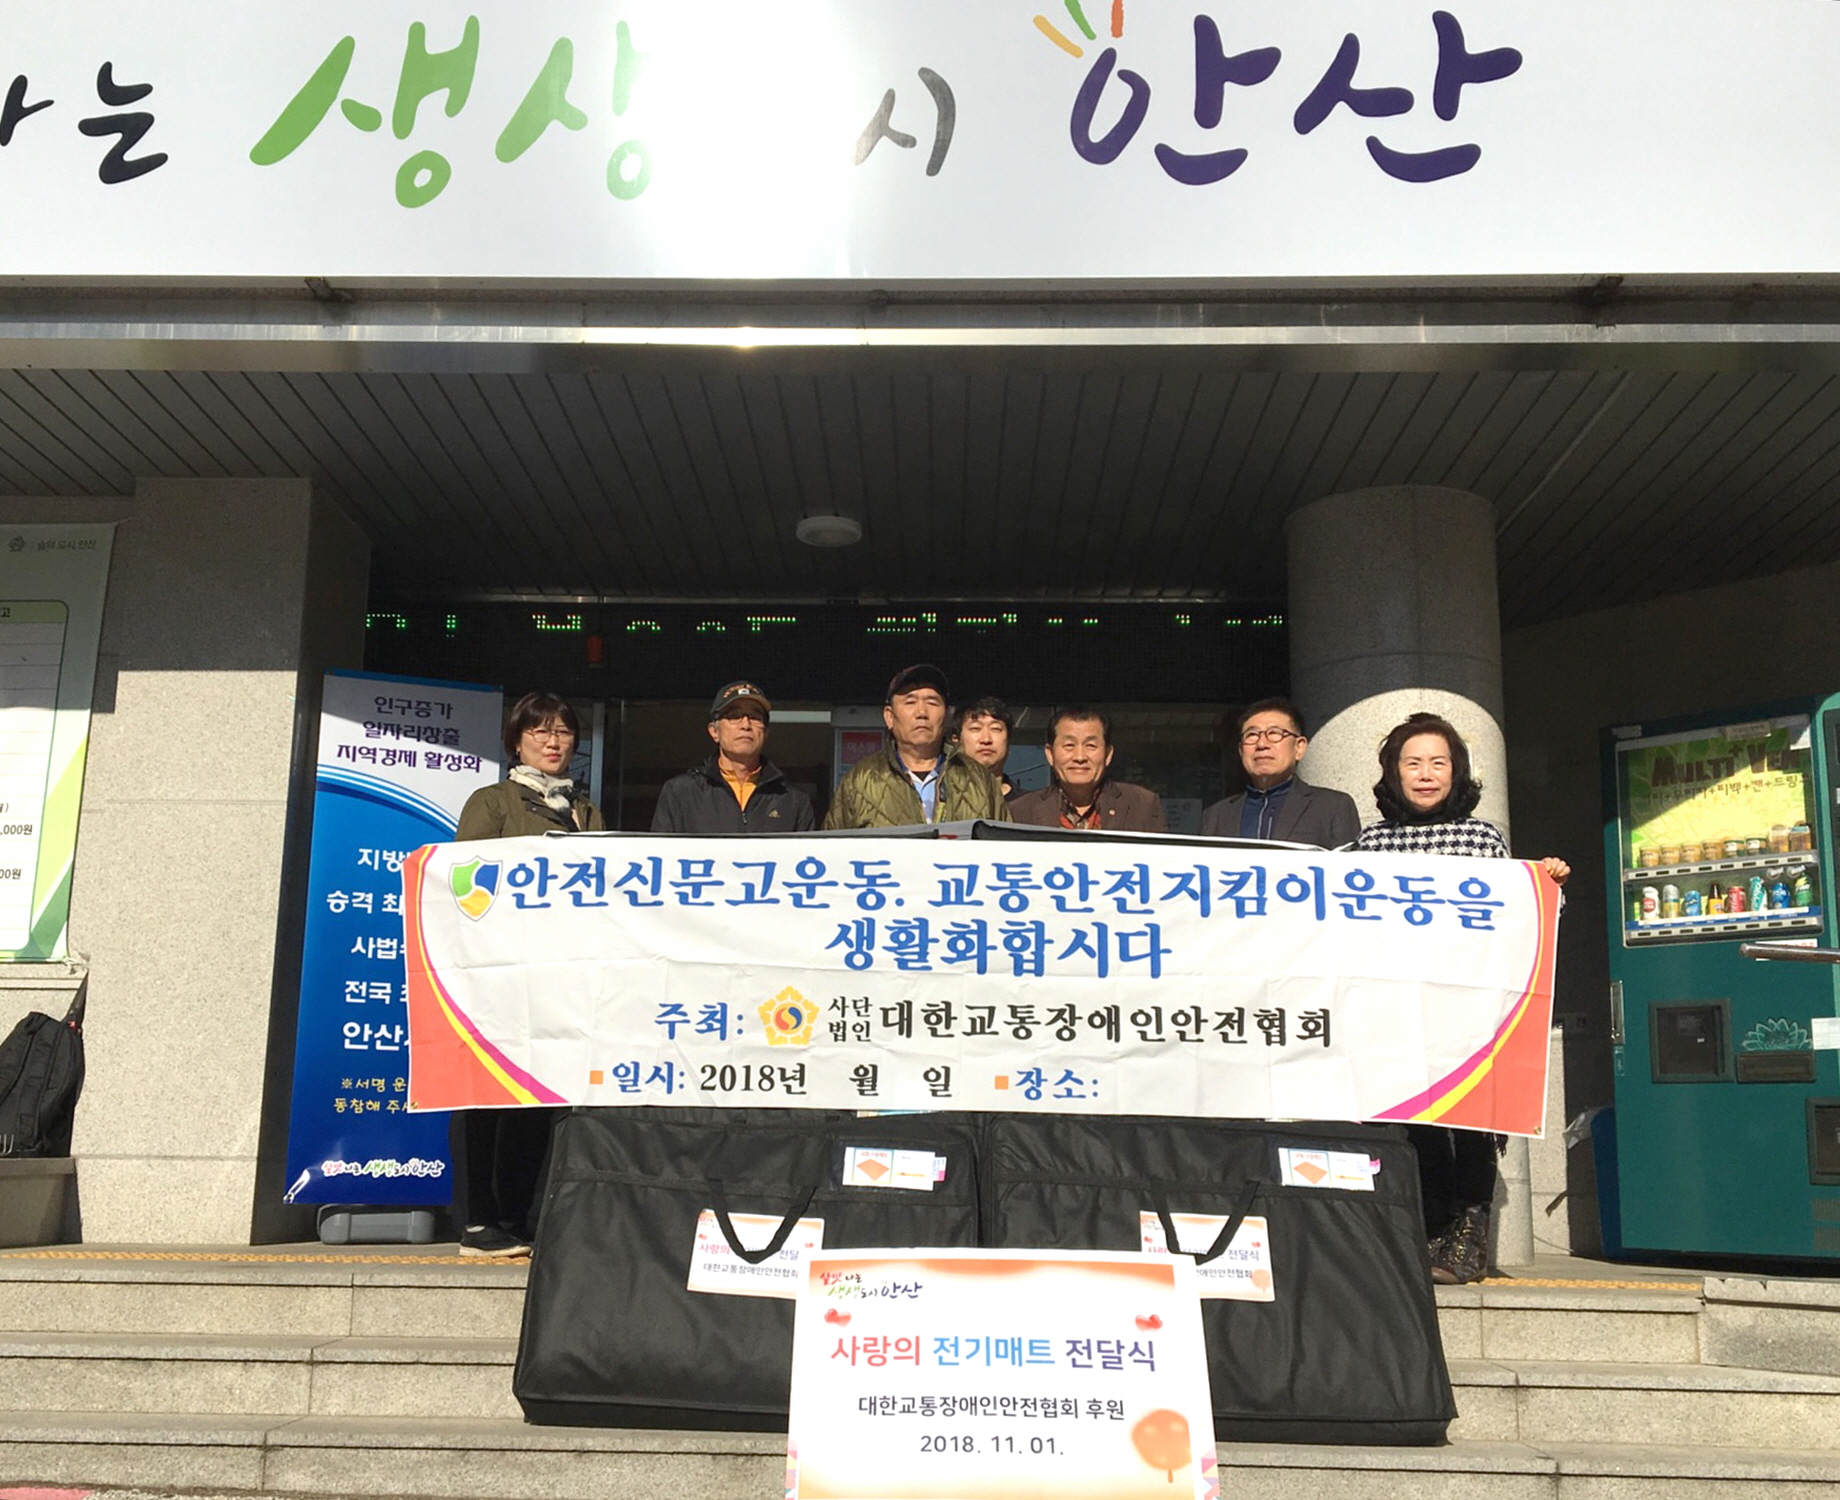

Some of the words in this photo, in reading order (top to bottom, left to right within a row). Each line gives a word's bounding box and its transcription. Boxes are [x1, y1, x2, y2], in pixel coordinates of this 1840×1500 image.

[1071, 10, 1522, 186] 안산
[374, 696, 453, 719] 인구증가
[363, 720, 460, 746] 일자리창출
[337, 744, 417, 768] 지역경제
[424, 752, 482, 773] 활성화
[357, 848, 410, 872] 지방
[327, 890, 373, 914] 승격
[928, 861, 1505, 930] 교통안전지킴이운동을
[351, 936, 405, 960] 사법
[825, 916, 1172, 978] 생활화합시다
[345, 980, 392, 1004] 전국
[828, 996, 873, 1018] 사단
[654, 1002, 744, 1041] 주최:
[828, 1021, 873, 1043] 법인
[880, 1001, 1332, 1048] 대한교통장애인안전협회
[343, 1021, 409, 1051] 안산
[612, 1061, 686, 1095] 일시:
[700, 1062, 807, 1097] 2018년
[849, 1064, 880, 1098] 월
[923, 1066, 952, 1099] 일
[1015, 1067, 1099, 1101] 장소:
[334, 1098, 381, 1114] 동참해
[779, 1249, 800, 1261] 전달
[1228, 1248, 1260, 1262] 전달식
[1196, 1268, 1253, 1279] 애인안전협회
[881, 1281, 923, 1299] 안산
[831, 1335, 921, 1368] 사랑의
[933, 1335, 1055, 1368] 전기매트
[1065, 1338, 1156, 1372] 전달식
[858, 1395, 1079, 1420] 대한교통장애인안전협회
[1086, 1398, 1125, 1421] 후원
[920, 1435, 981, 1454] 2018.
[991, 1435, 1022, 1455] 11.
[1030, 1436, 1064, 1456] 01.
